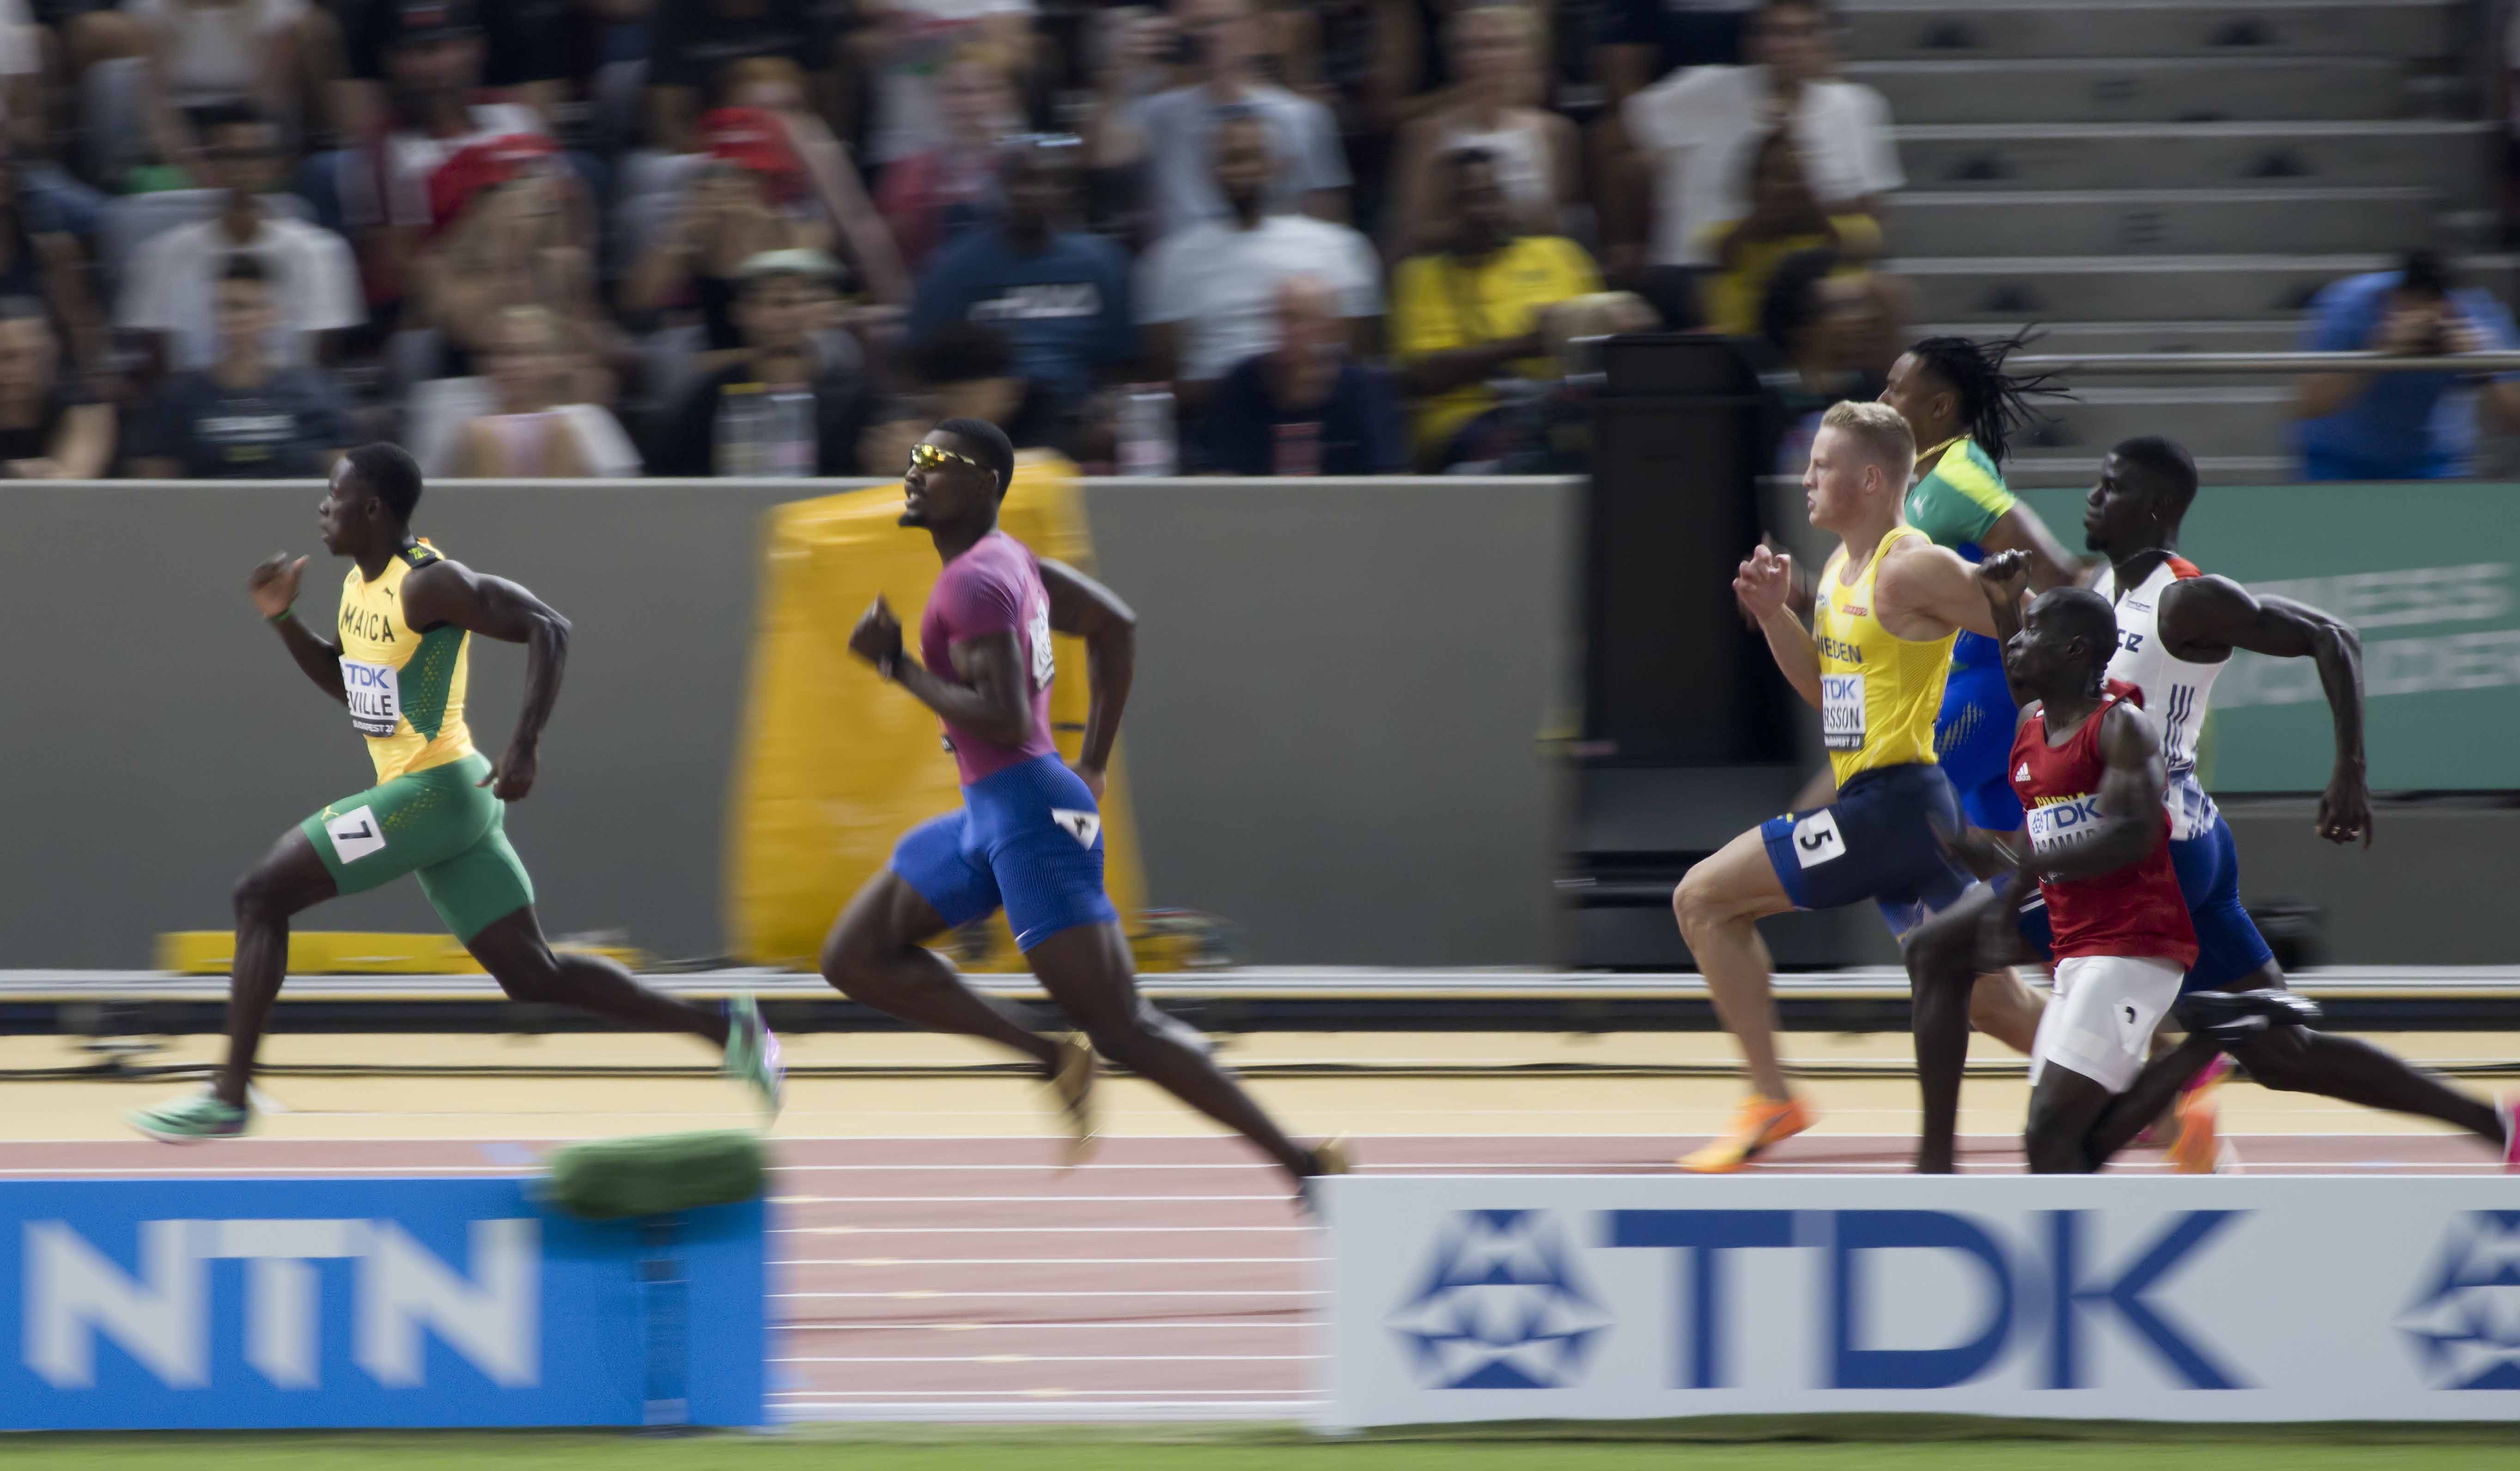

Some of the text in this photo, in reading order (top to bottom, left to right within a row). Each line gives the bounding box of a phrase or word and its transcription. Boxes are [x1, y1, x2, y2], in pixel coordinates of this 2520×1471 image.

[341, 602, 396, 643] MAICA
[345, 663, 390, 689] TDK
[1823, 679, 1856, 699] TDK
[347, 691, 393, 716] VILLE
[2043, 798, 2103, 831] TDK
[337, 820, 372, 840] 7
[1800, 828, 1833, 850] 5
[21, 1218, 542, 1386] NTN
[1587, 1209, 2262, 1389] TDK
